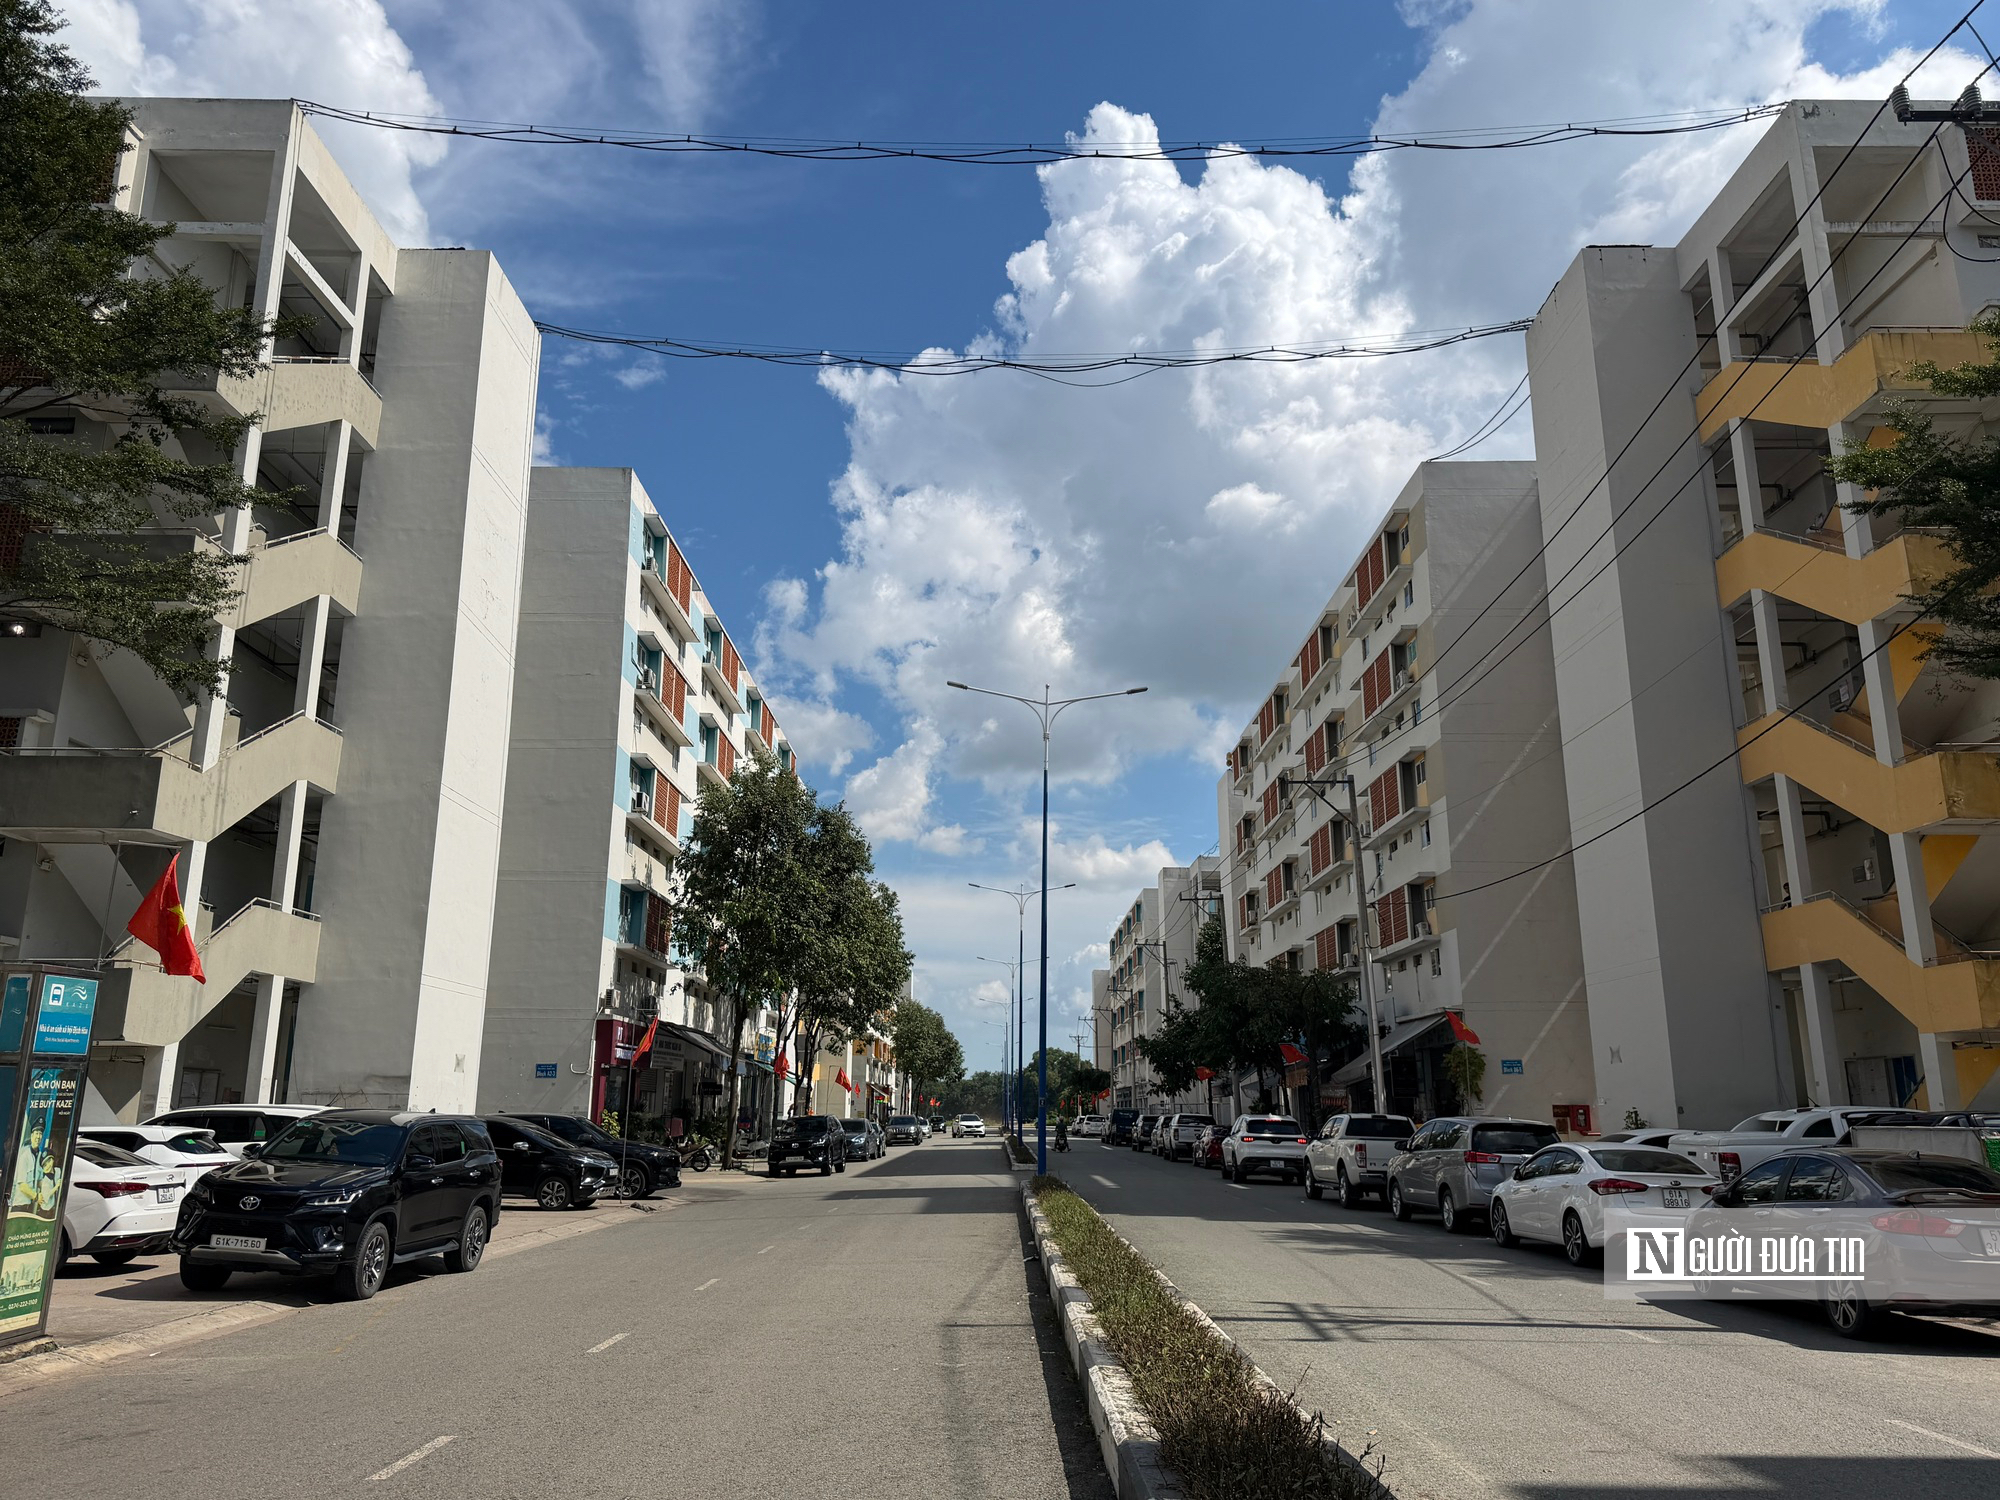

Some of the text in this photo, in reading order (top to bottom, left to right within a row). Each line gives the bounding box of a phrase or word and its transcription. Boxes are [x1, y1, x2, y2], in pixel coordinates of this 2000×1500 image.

[30, 1099, 39, 1109] XE
[56, 1099, 73, 1108] KAZE
[1668, 1189, 1683, 1198] 61A
[215, 1237, 262, 1249] 61K-715.60
